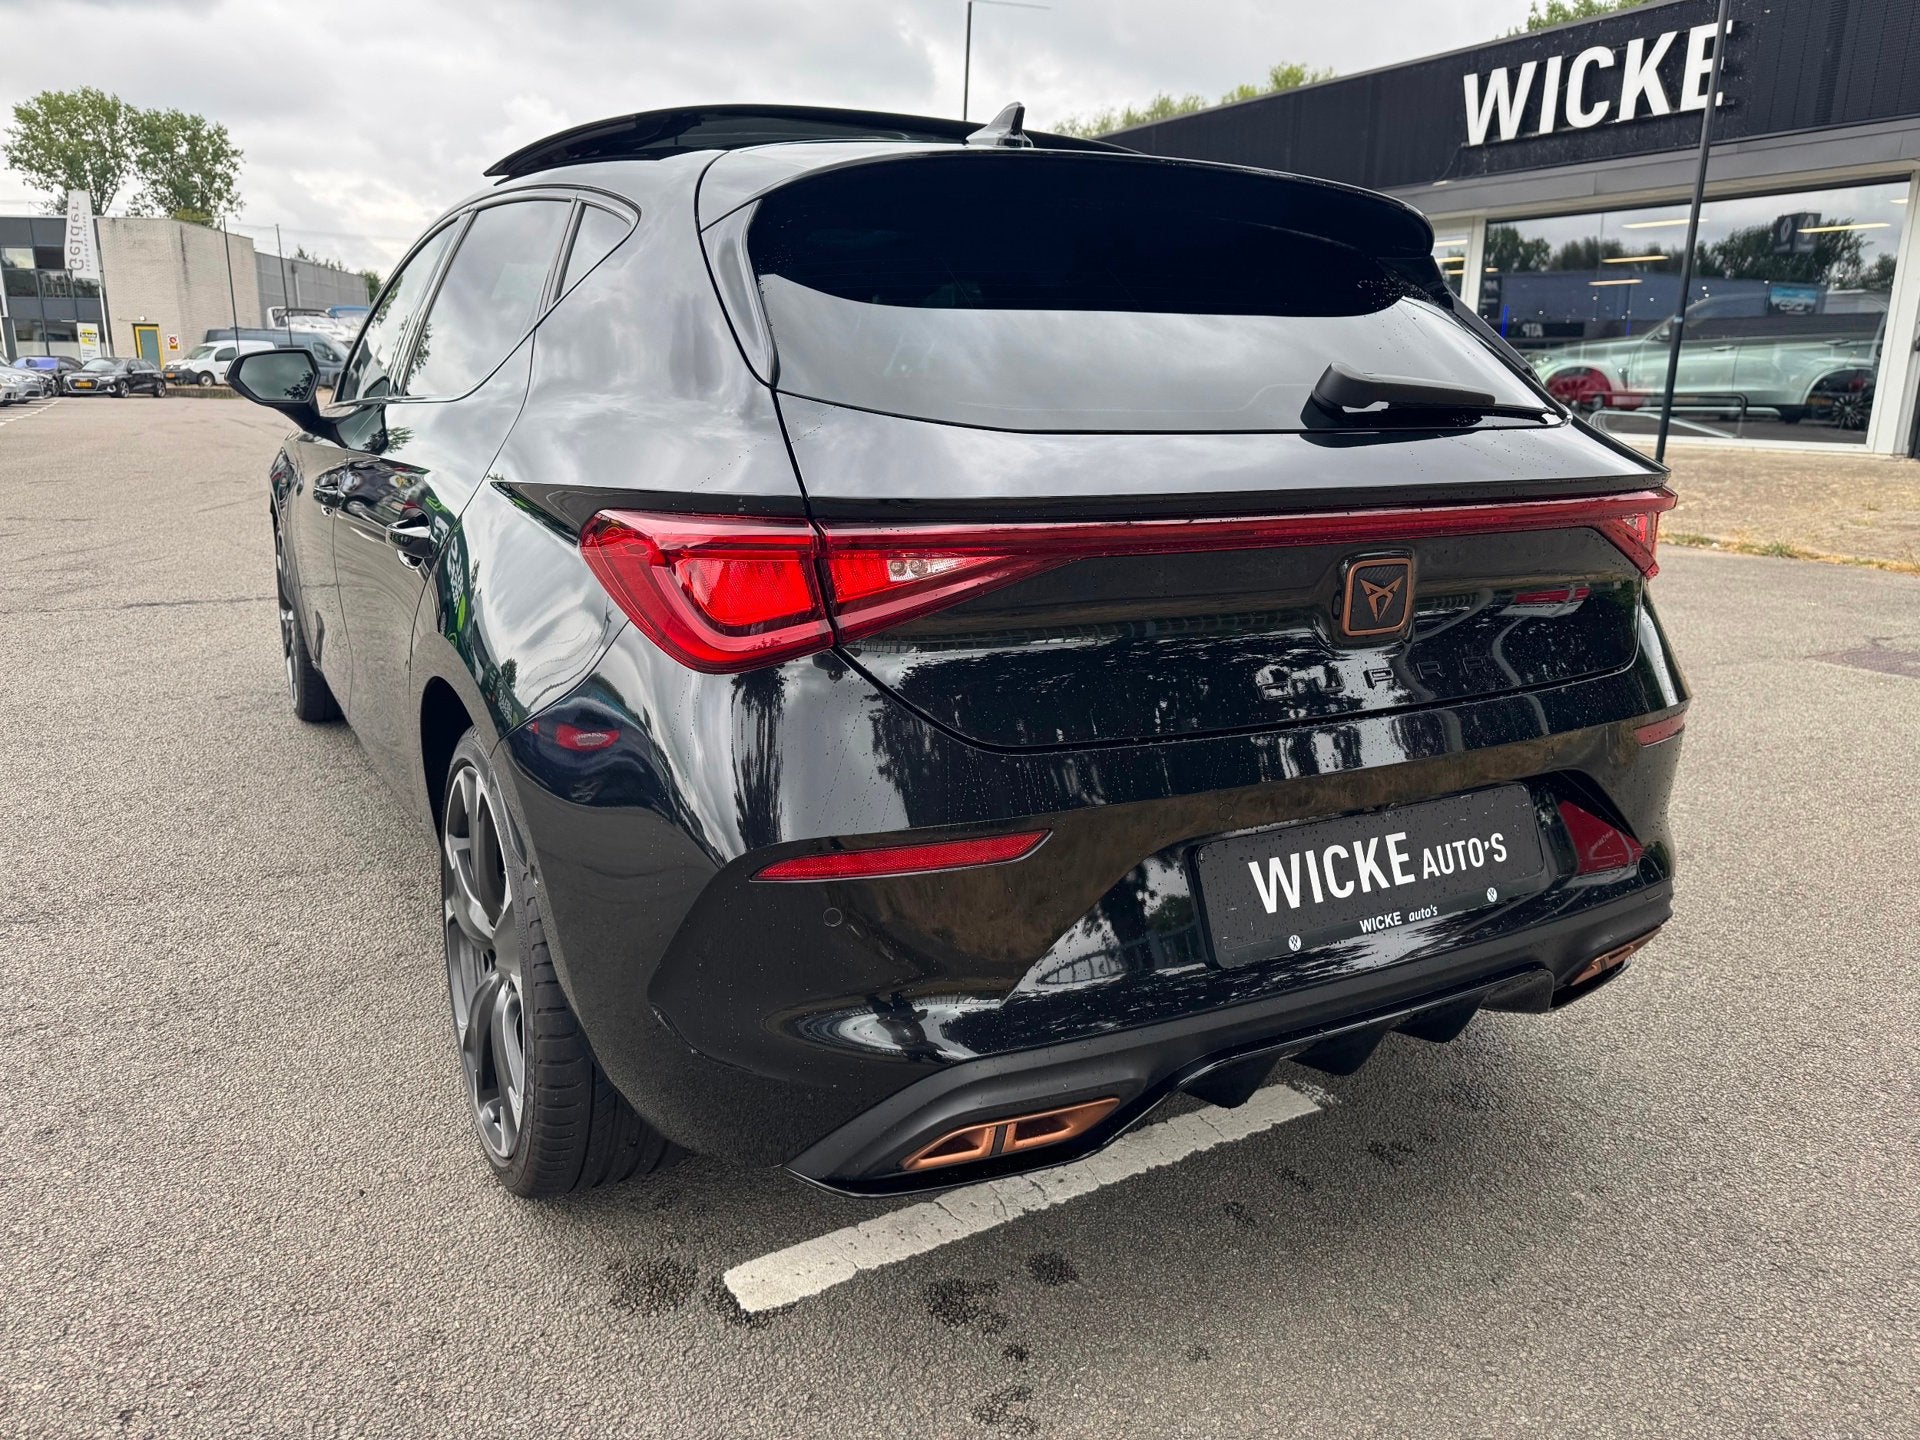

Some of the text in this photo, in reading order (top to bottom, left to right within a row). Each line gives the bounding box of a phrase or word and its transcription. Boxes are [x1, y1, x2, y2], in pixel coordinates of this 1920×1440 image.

[1463, 19, 1733, 147] WICKE
[1248, 831, 1508, 914] WICKE AUTO'S
[1359, 904, 1438, 933] WICKE auto's
